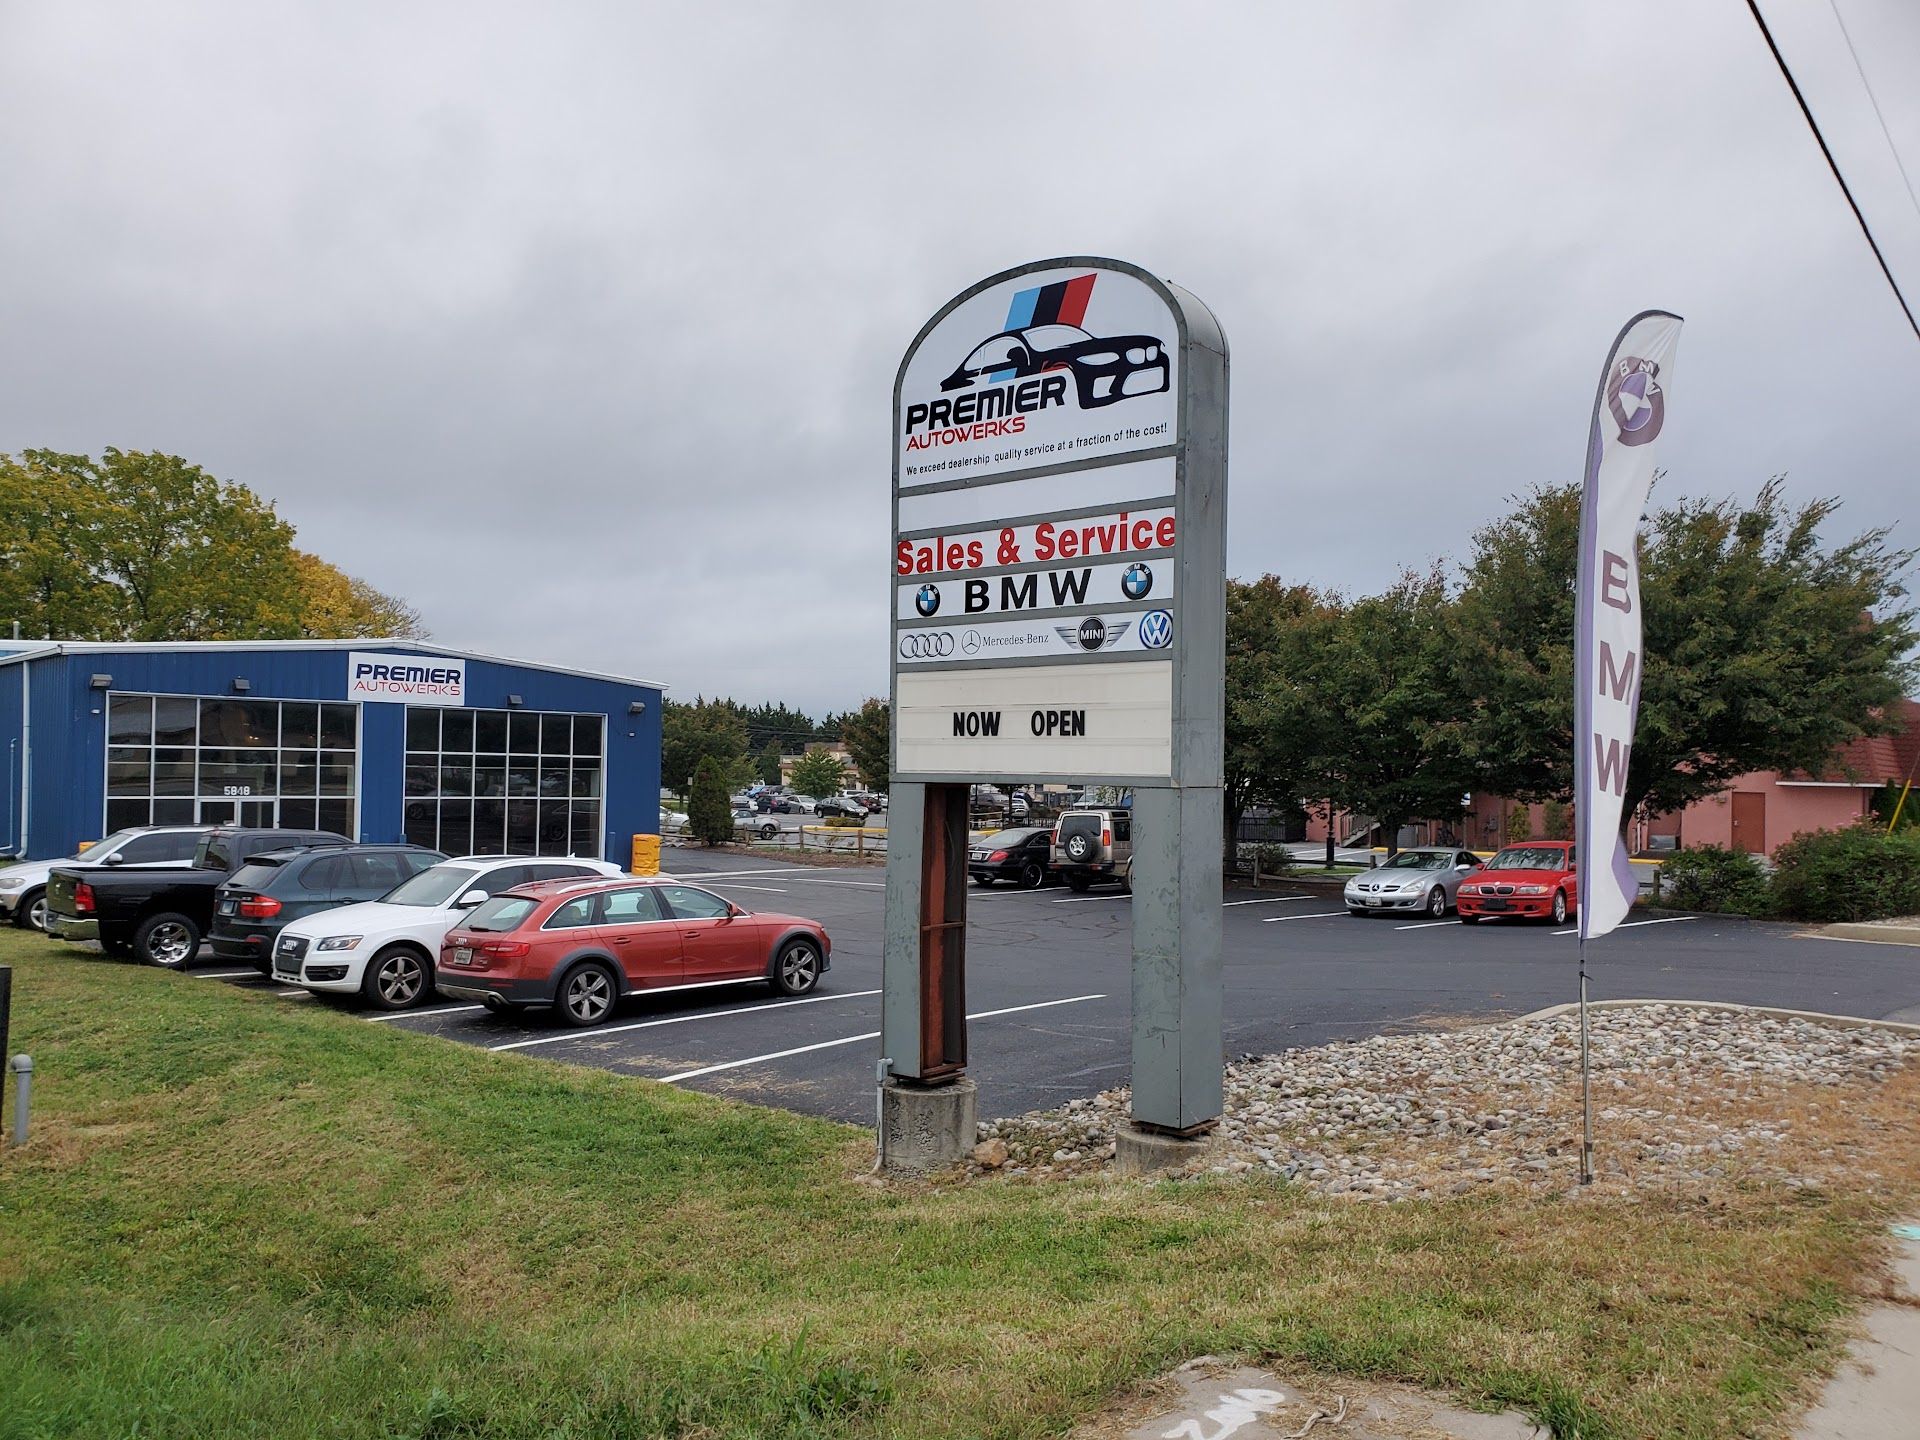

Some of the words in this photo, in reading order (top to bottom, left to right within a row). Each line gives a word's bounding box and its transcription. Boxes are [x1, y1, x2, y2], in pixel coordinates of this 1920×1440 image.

[905, 375, 1067, 434] PREMIER
[906, 415, 1026, 452] AUTOWERKS
[906, 465, 918, 476] We
[919, 460, 946, 475] exceed
[948, 454, 990, 469] dealership
[994, 448, 1022, 463] quality
[1024, 443, 1055, 457] service
[1057, 440, 1066, 451] at
[1068, 439, 1074, 449] a
[1076, 433, 1111, 448] fraction
[1113, 429, 1123, 442] of
[1125, 427, 1141, 439] the
[1143, 422, 1168, 436] cost!
[898, 535, 984, 575] Sales
[997, 527, 1021, 565] &
[1034, 511, 1176, 561] Service
[964, 568, 1093, 614] BMW
[982, 633, 1049, 647] Mercedes-Benz
[1080, 628, 1104, 640] MINI
[354, 680, 461, 696] AUTOWERKS
[356, 663, 461, 684] PREMIER
[1593, 549, 1636, 797] BMW
[953, 711, 1001, 737] NOW
[1031, 710, 1086, 737] OPEN
[223, 785, 251, 796] 5848
